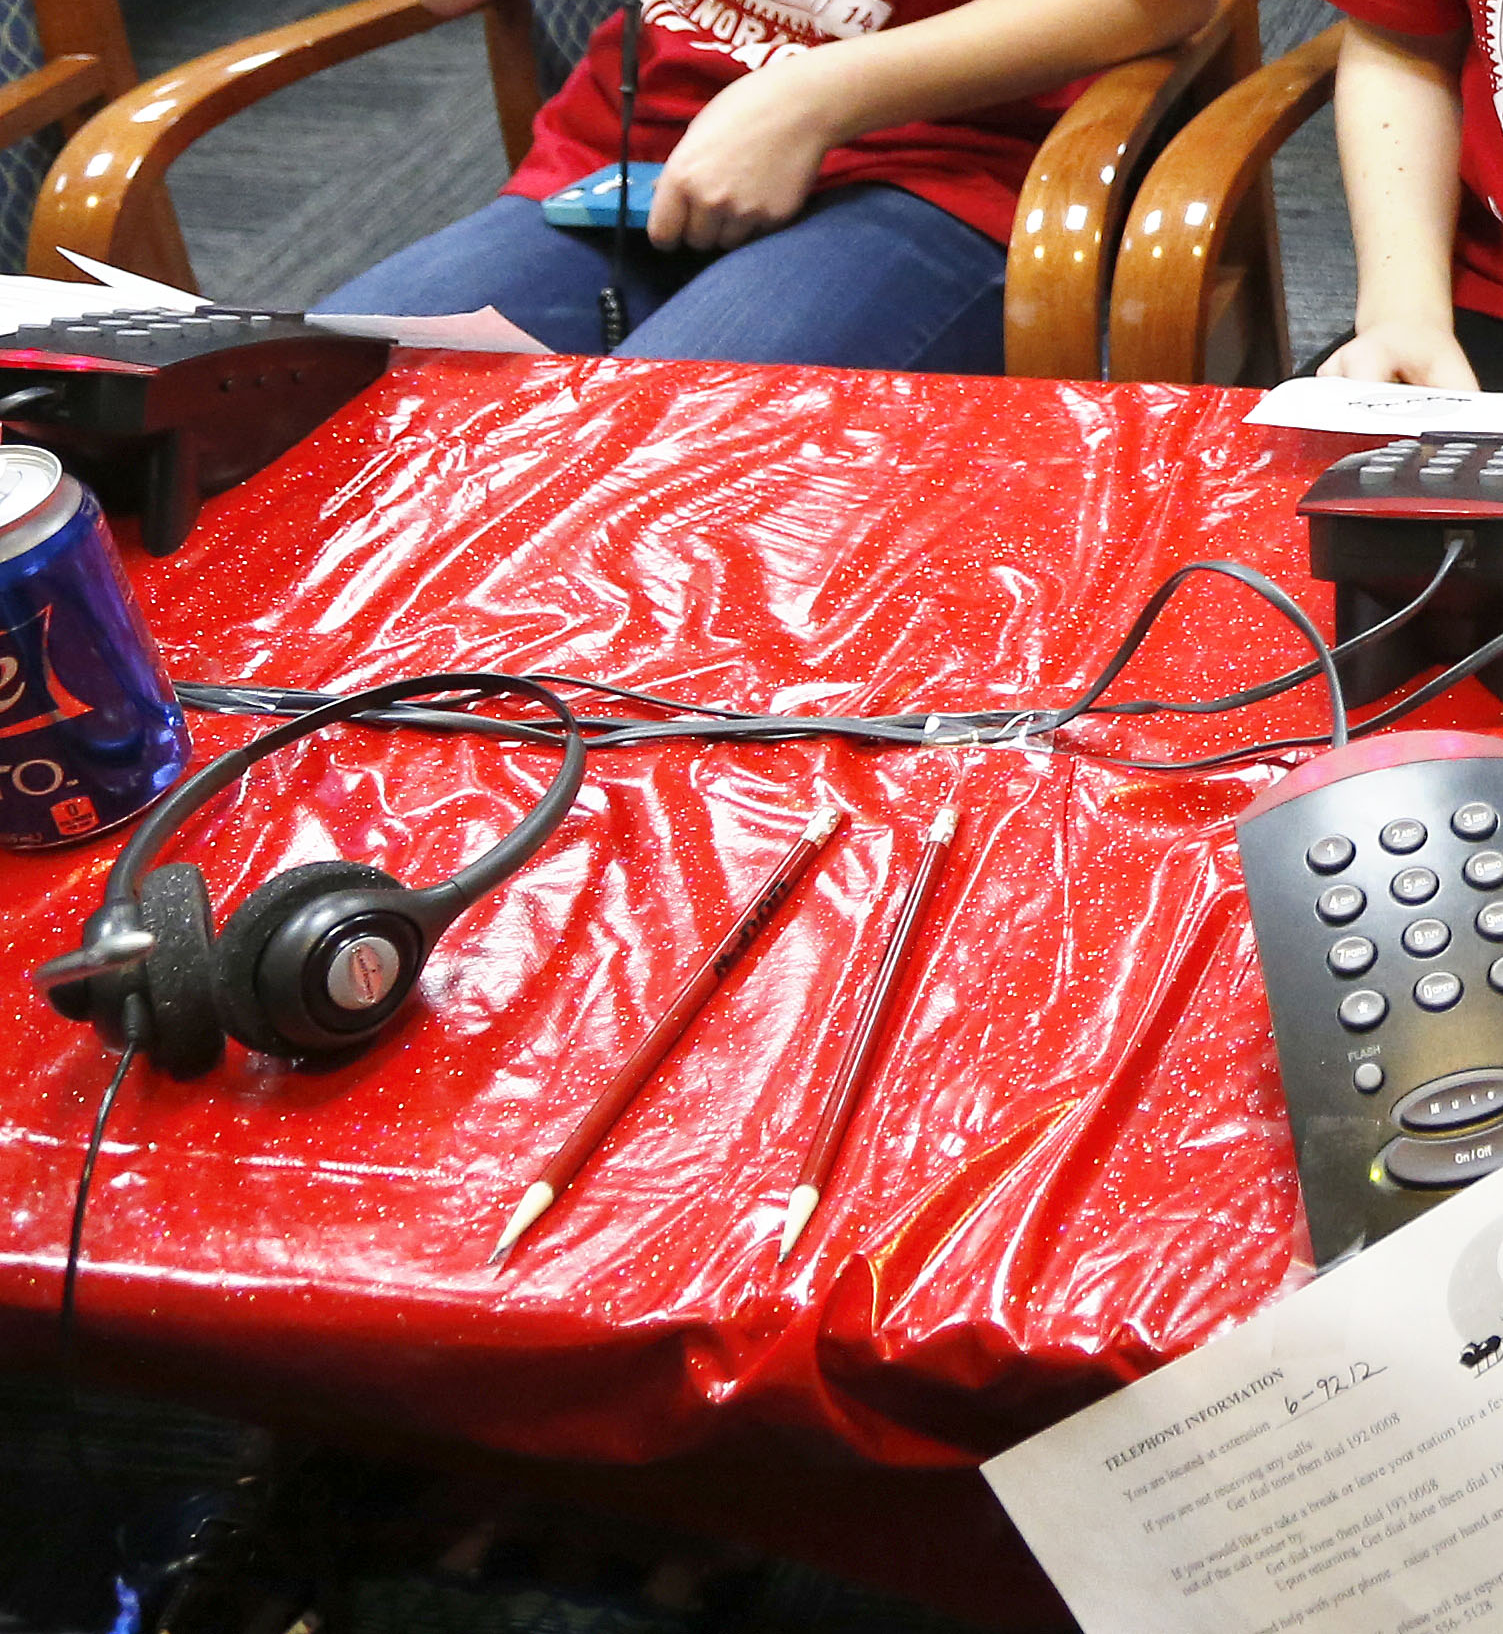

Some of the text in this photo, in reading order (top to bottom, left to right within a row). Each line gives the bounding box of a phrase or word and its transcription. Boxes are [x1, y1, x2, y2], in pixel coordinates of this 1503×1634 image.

[1463, 813, 1473, 827] 3
[1391, 829, 1402, 843] 2
[1403, 878, 1412, 892] 5
[1329, 895, 1338, 911] 4
[1413, 930, 1423, 944] 8
[1337, 949, 1346, 963] 7
[1347, 1044, 1382, 1063] FLASH
[1283, 1361, 1387, 1414] 6-9212
[1104, 1370, 1283, 1471] TELEPHONE INFORMATION
[1340, 1483, 1354, 1496] or
[1354, 1466, 1386, 1488] leave
[1387, 1449, 1414, 1474] your
[1416, 1426, 1456, 1453] station
[1456, 1414, 1475, 1431] for
[1478, 1408, 1487, 1419] a
[1332, 1585, 1356, 1608] your
[1402, 1548, 1430, 1568] raise
[1431, 1532, 1458, 1556] your
[1457, 1513, 1489, 1538] hand
[1452, 1590, 1472, 1606] the
